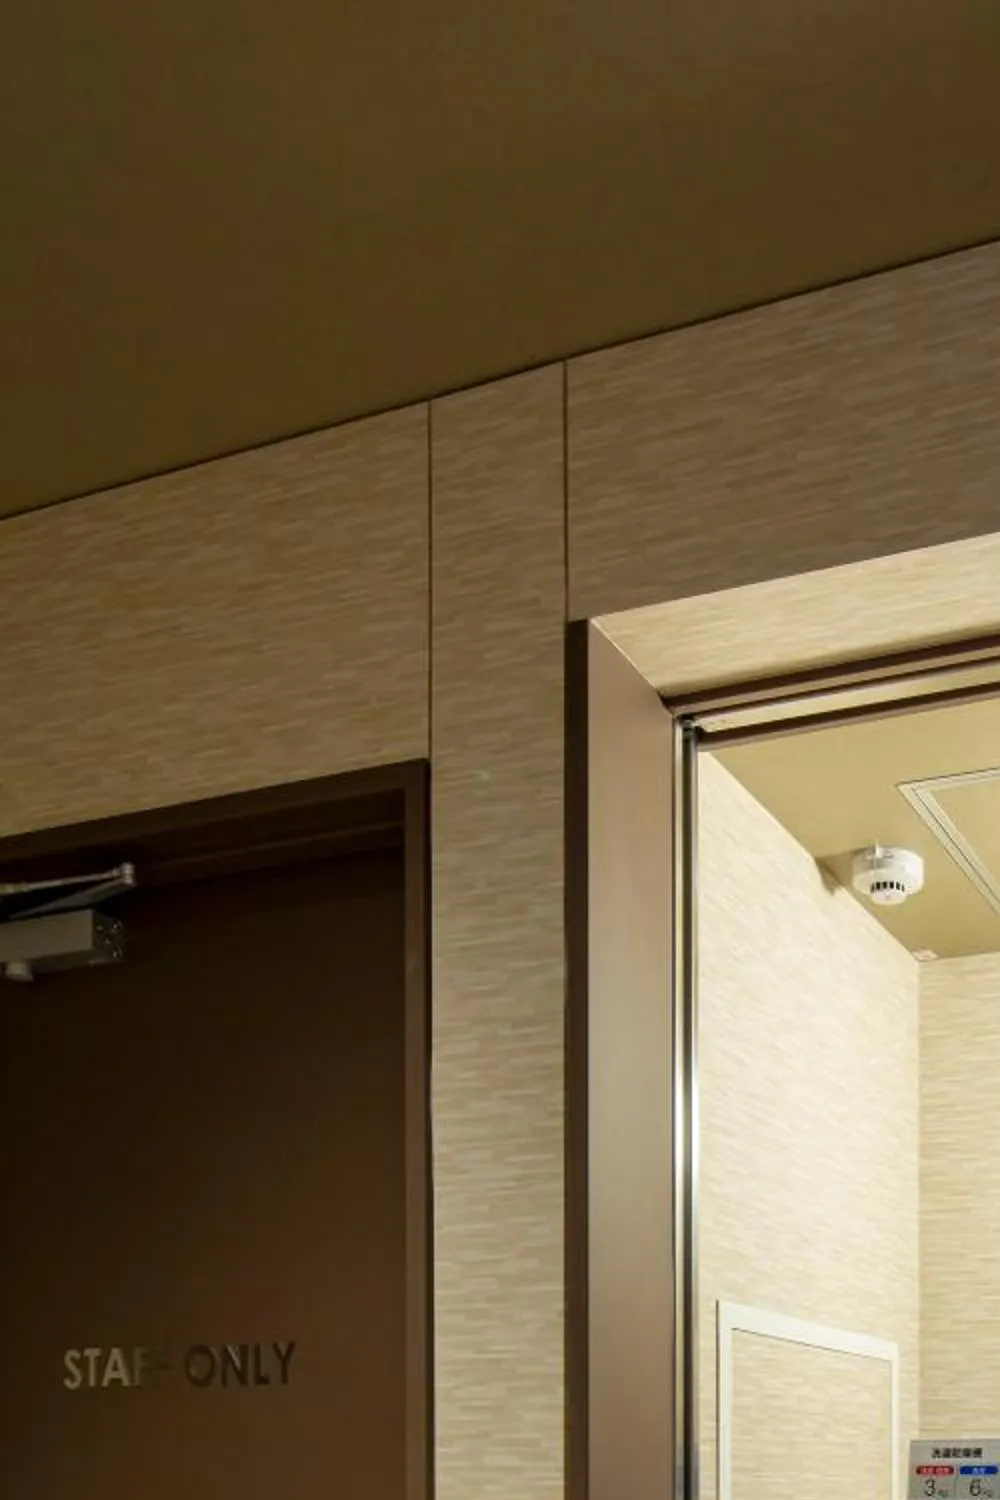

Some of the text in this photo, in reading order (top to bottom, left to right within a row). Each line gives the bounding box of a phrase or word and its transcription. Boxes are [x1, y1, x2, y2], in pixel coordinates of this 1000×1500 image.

[184, 1342, 295, 1388] ONLY
[924, 1479, 936, 1497] 3
[969, 1479, 981, 1497] 6
